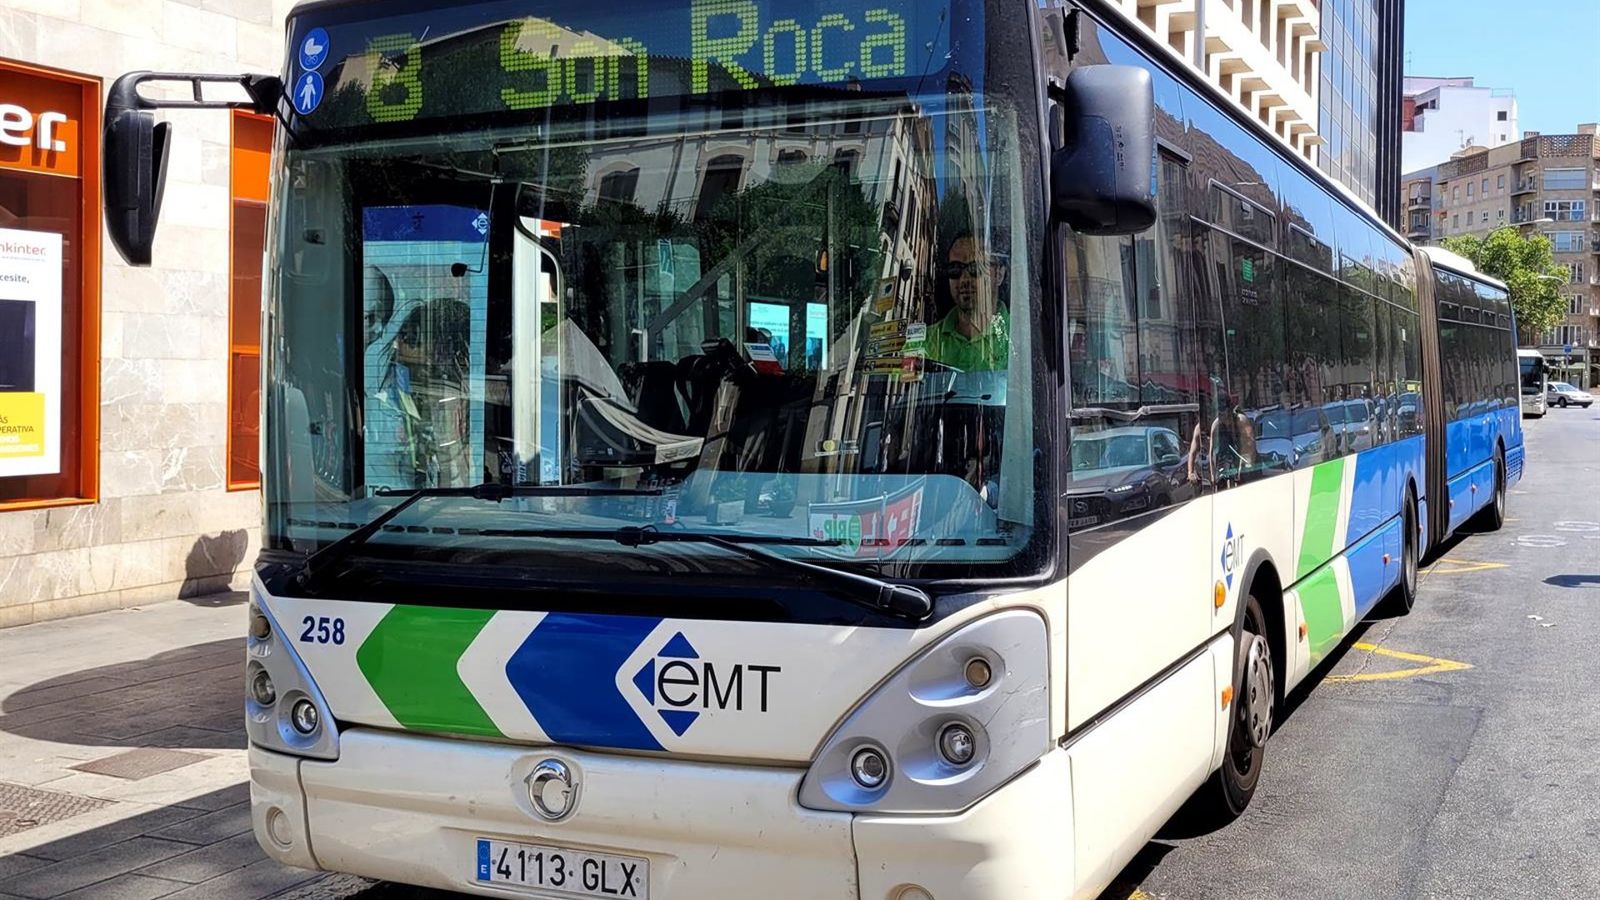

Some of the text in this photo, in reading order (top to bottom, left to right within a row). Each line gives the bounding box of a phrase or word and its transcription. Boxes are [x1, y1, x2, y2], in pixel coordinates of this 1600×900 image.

[365, 0, 906, 123] 8 Son Roca
[0, 425, 34, 434] ERATIVA
[300, 615, 345, 645] 258
[480, 847, 637, 897] E 4113 GLX
